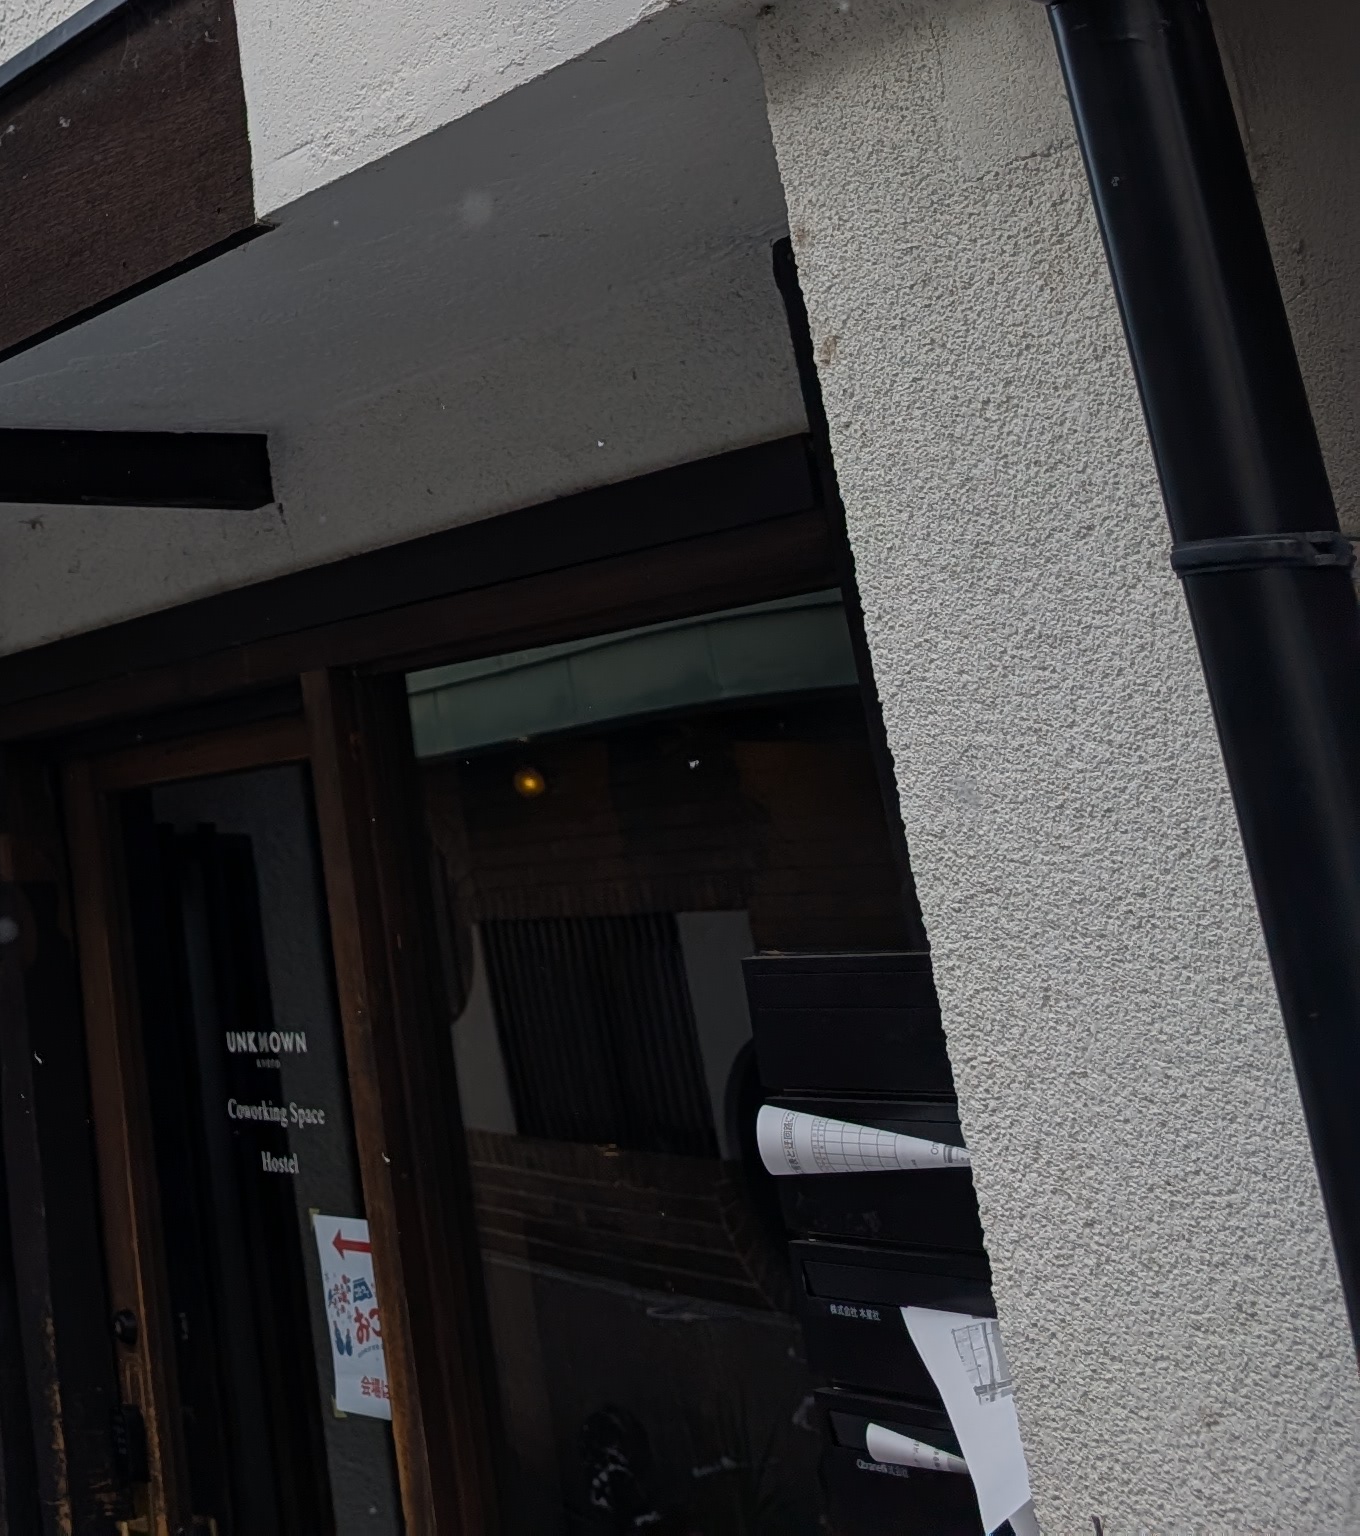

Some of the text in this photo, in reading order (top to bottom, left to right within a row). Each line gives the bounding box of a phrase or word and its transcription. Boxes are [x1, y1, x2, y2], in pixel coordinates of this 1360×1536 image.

[225, 1030, 308, 1054] UNKNOWN
[227, 1097, 326, 1129] Coworking Space
[261, 1150, 300, 1175] Hostel
